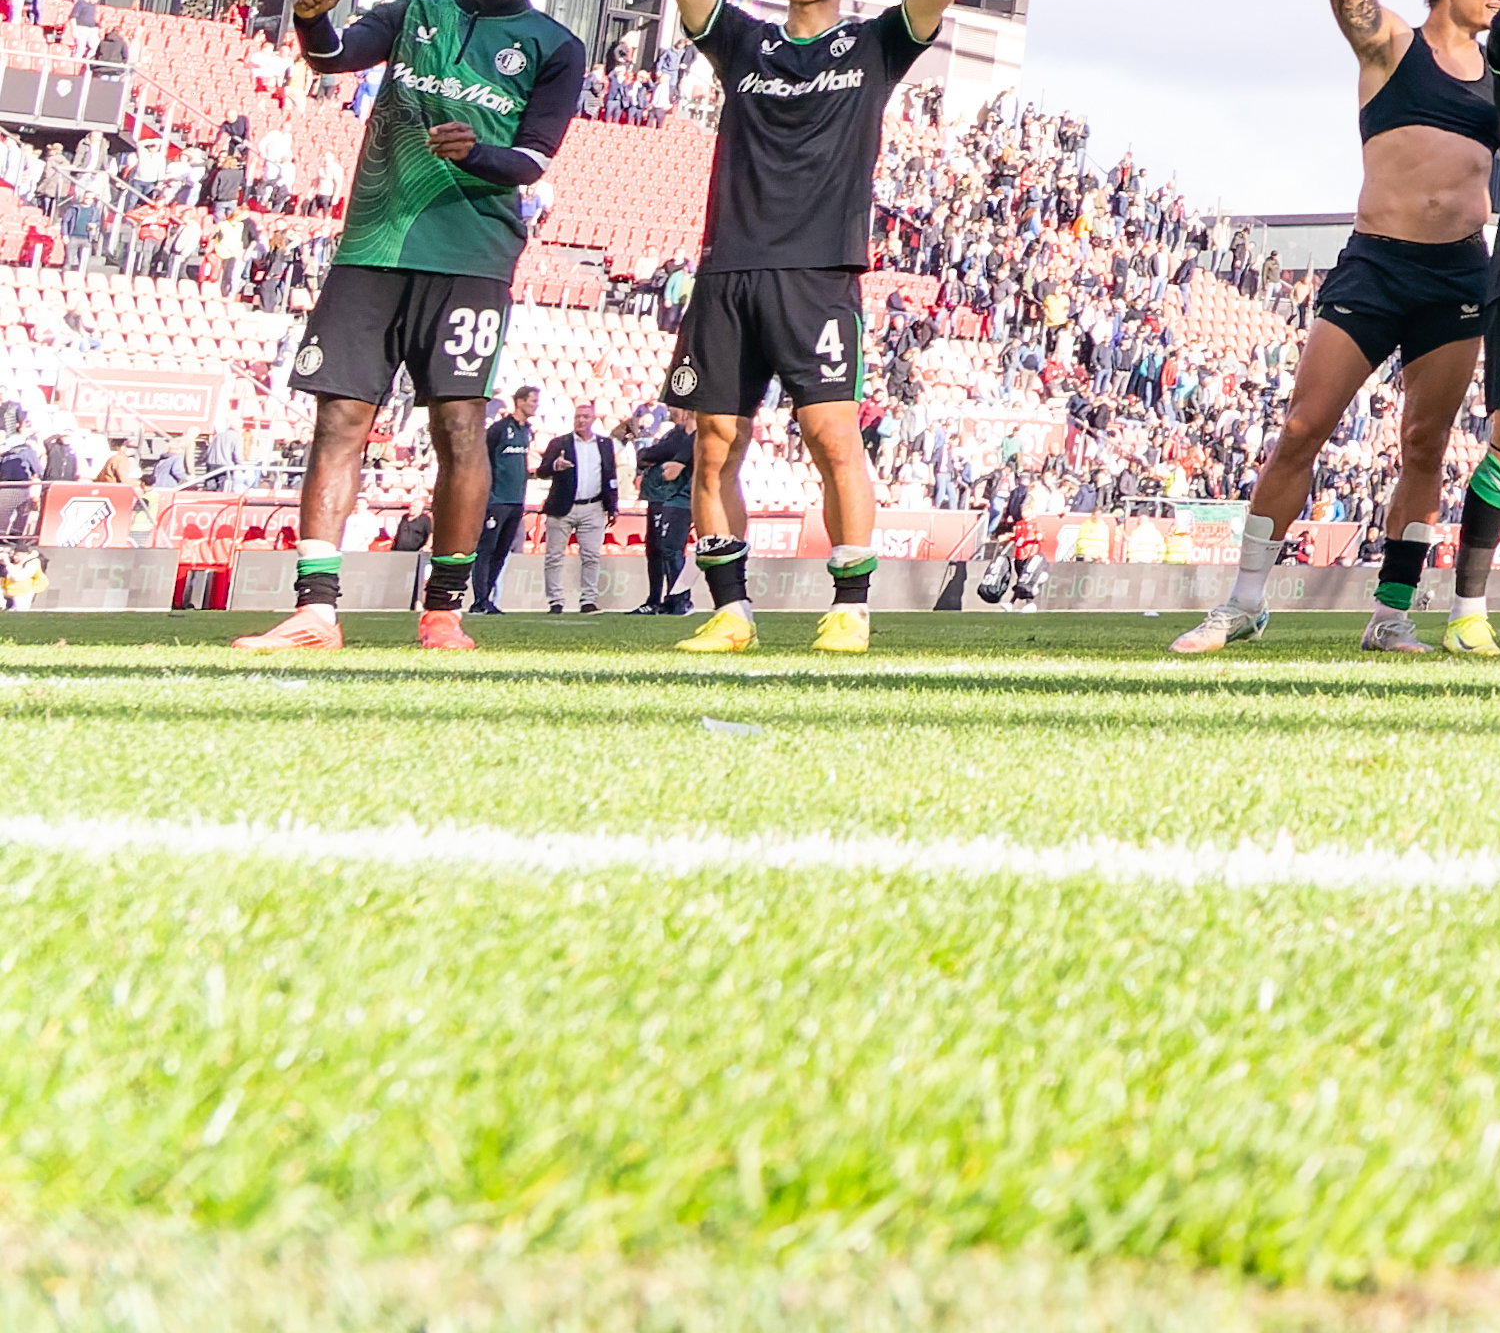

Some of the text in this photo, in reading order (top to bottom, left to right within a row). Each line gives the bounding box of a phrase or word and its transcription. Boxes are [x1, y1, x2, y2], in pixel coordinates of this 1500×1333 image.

[443, 307, 501, 357] 38
[815, 318, 845, 362] 4
[77, 389, 201, 412] CONCLUSION
[181, 509, 300, 530] CONCLUSIO
